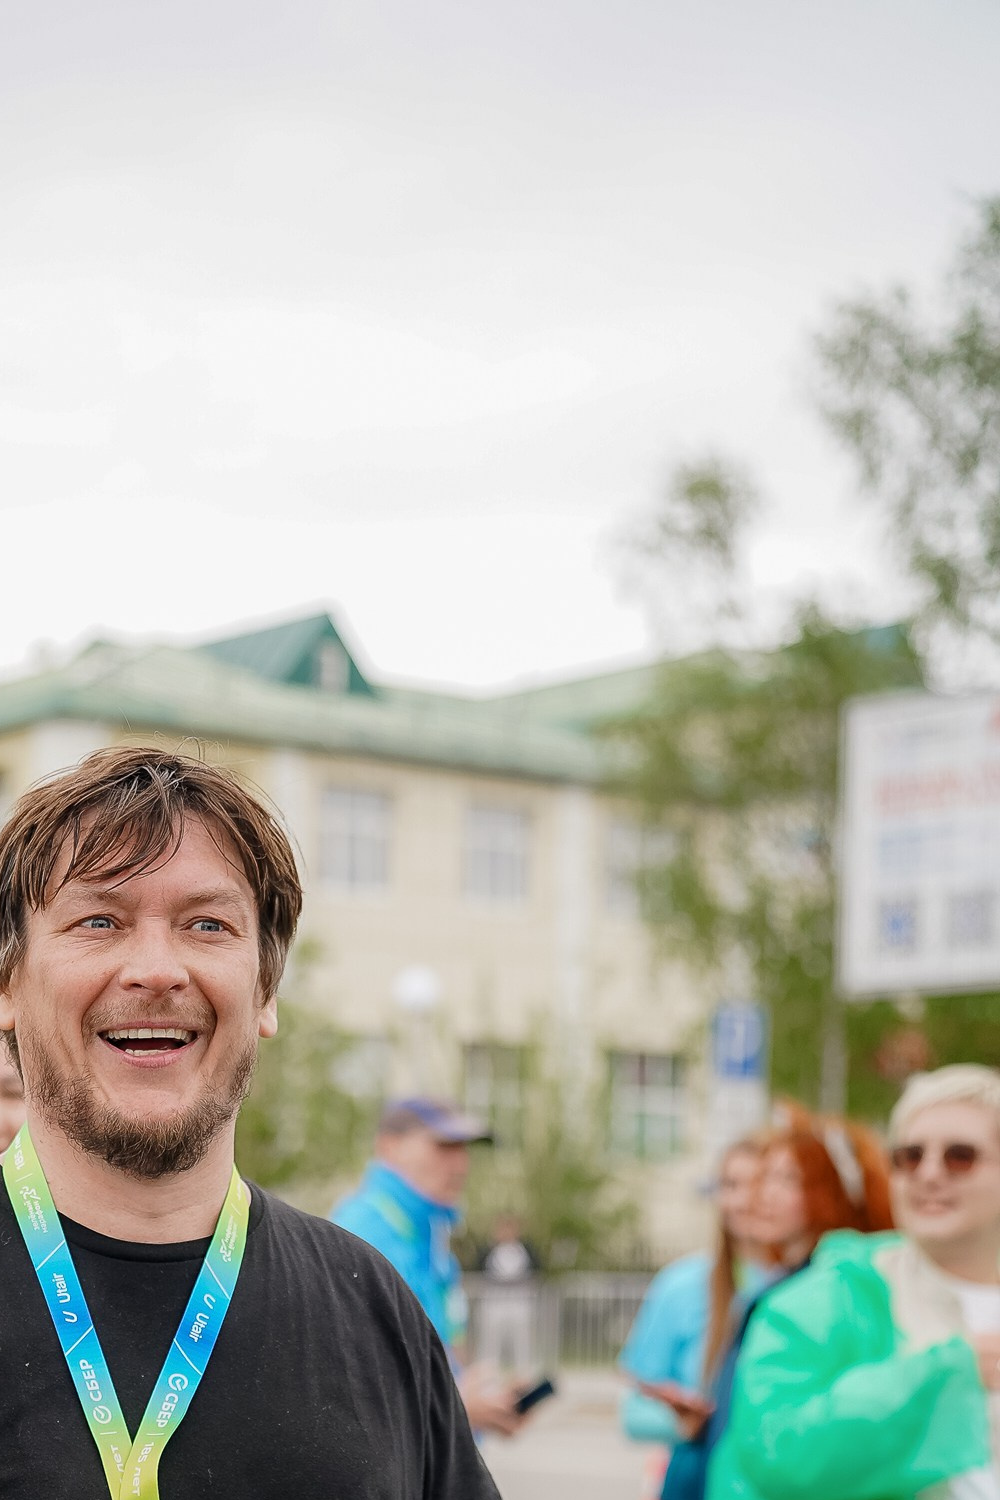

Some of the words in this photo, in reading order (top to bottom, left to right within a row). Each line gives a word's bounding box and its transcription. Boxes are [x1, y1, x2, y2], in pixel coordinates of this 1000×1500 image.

[34, 1200, 48, 1233] марафон
[52, 1273, 71, 1304] Utair
[189, 1312, 210, 1343] Utair
[79, 1359, 103, 1402] СБЕР
[156, 1392, 179, 1428] СБЕР
[137, 1442, 155, 1463] 185
